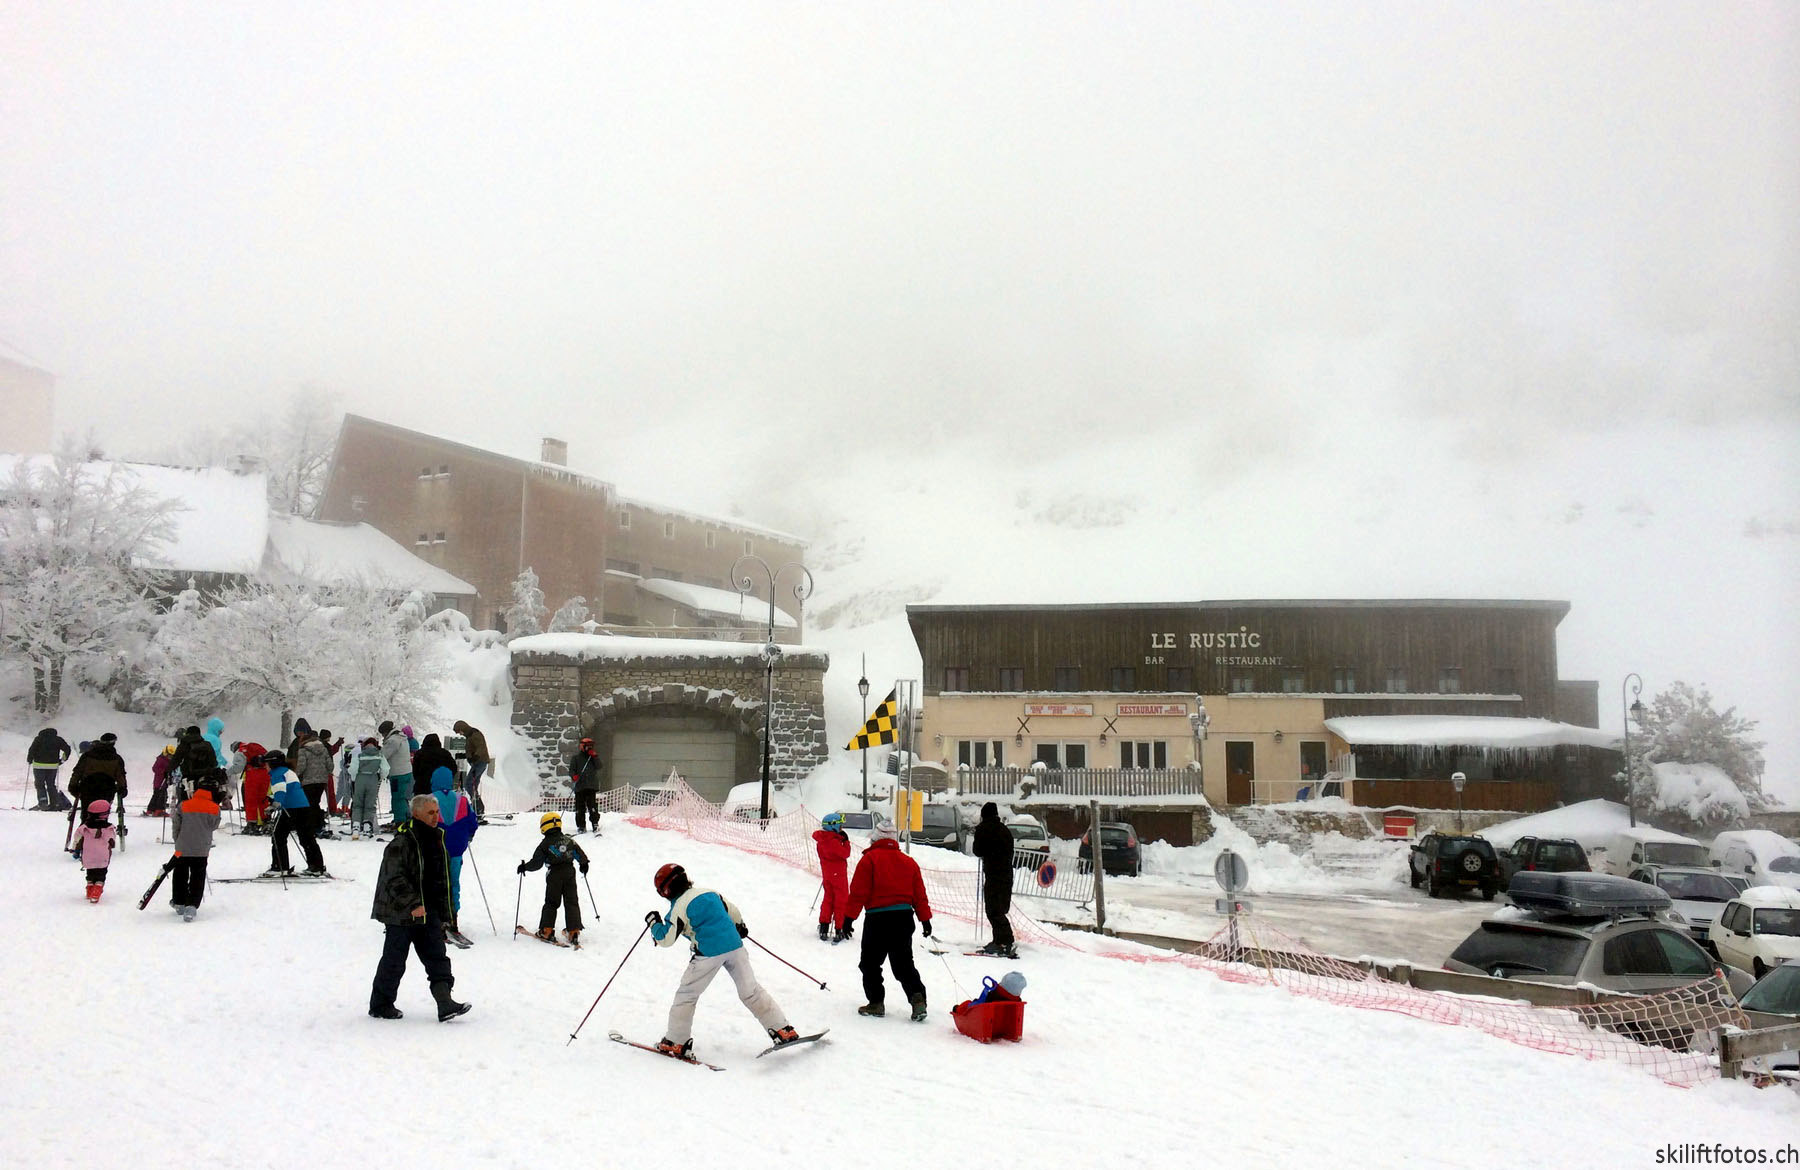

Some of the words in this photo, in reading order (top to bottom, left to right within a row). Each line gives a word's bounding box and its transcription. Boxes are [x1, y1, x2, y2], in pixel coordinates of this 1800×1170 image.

[1151, 633, 1177, 649] LE
[1144, 656, 1166, 665] BAR
[1215, 656, 1284, 665] RESTAURANT
[1119, 705, 1164, 715] RESTAURANT
